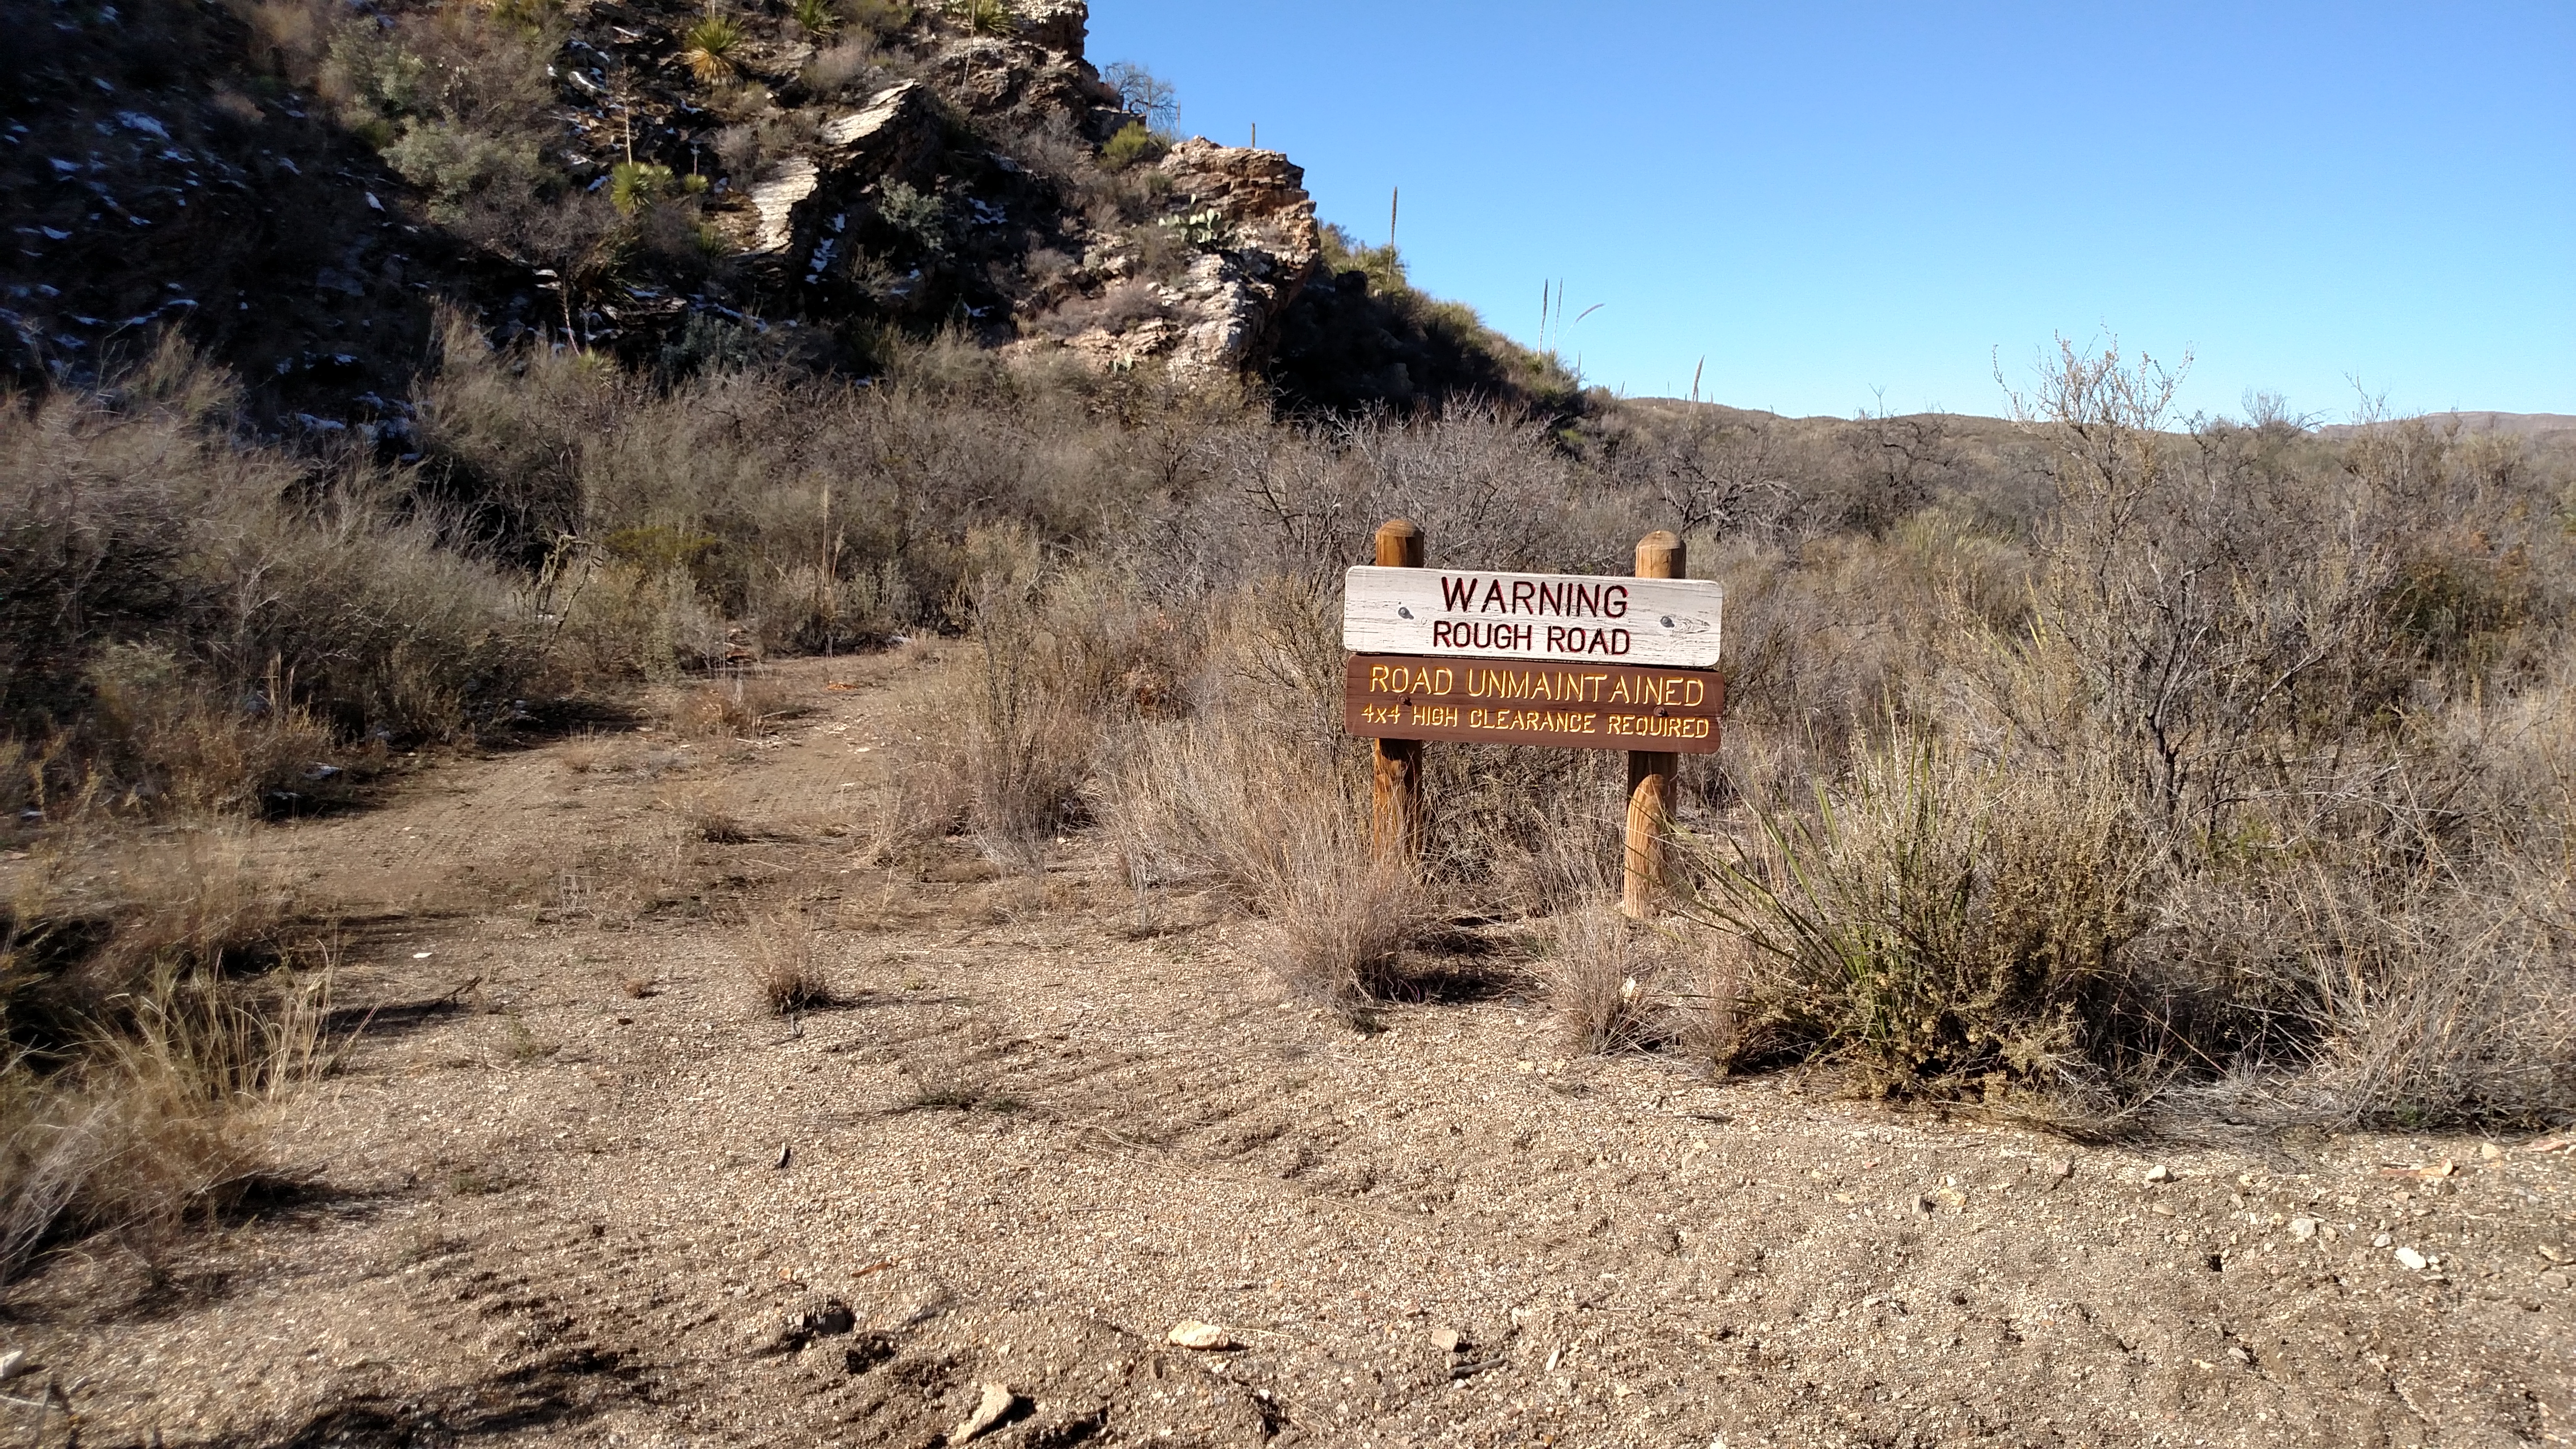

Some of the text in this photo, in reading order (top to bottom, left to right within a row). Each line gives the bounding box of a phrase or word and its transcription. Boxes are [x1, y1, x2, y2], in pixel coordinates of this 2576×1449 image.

[1441, 576, 1630, 618] WARNING
[1433, 620, 1631, 655] ROUGH ROAD
[1369, 665, 1704, 707] ROAD UNMAINTAINED
[1361, 703, 1709, 739] 4x4 HIGH CLEARANCE REQUIRED
